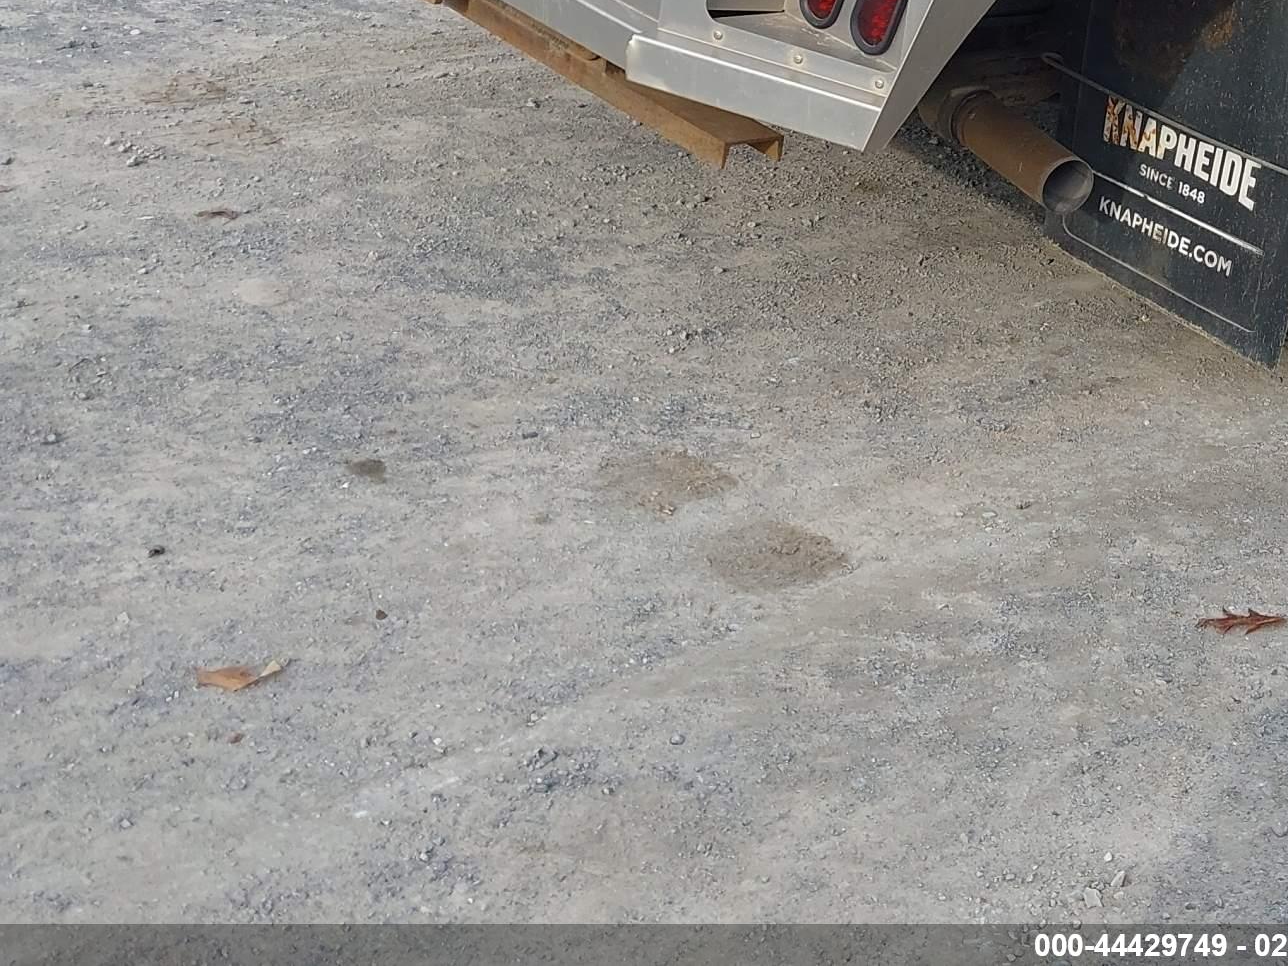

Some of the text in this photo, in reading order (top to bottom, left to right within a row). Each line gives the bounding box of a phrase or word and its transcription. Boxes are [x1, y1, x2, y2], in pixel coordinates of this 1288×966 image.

[1103, 94, 1262, 212] KNAPHEIDE
[1138, 163, 1206, 204] SINCE 1848
[1099, 196, 1233, 277] KNAPHEIDE.COM
